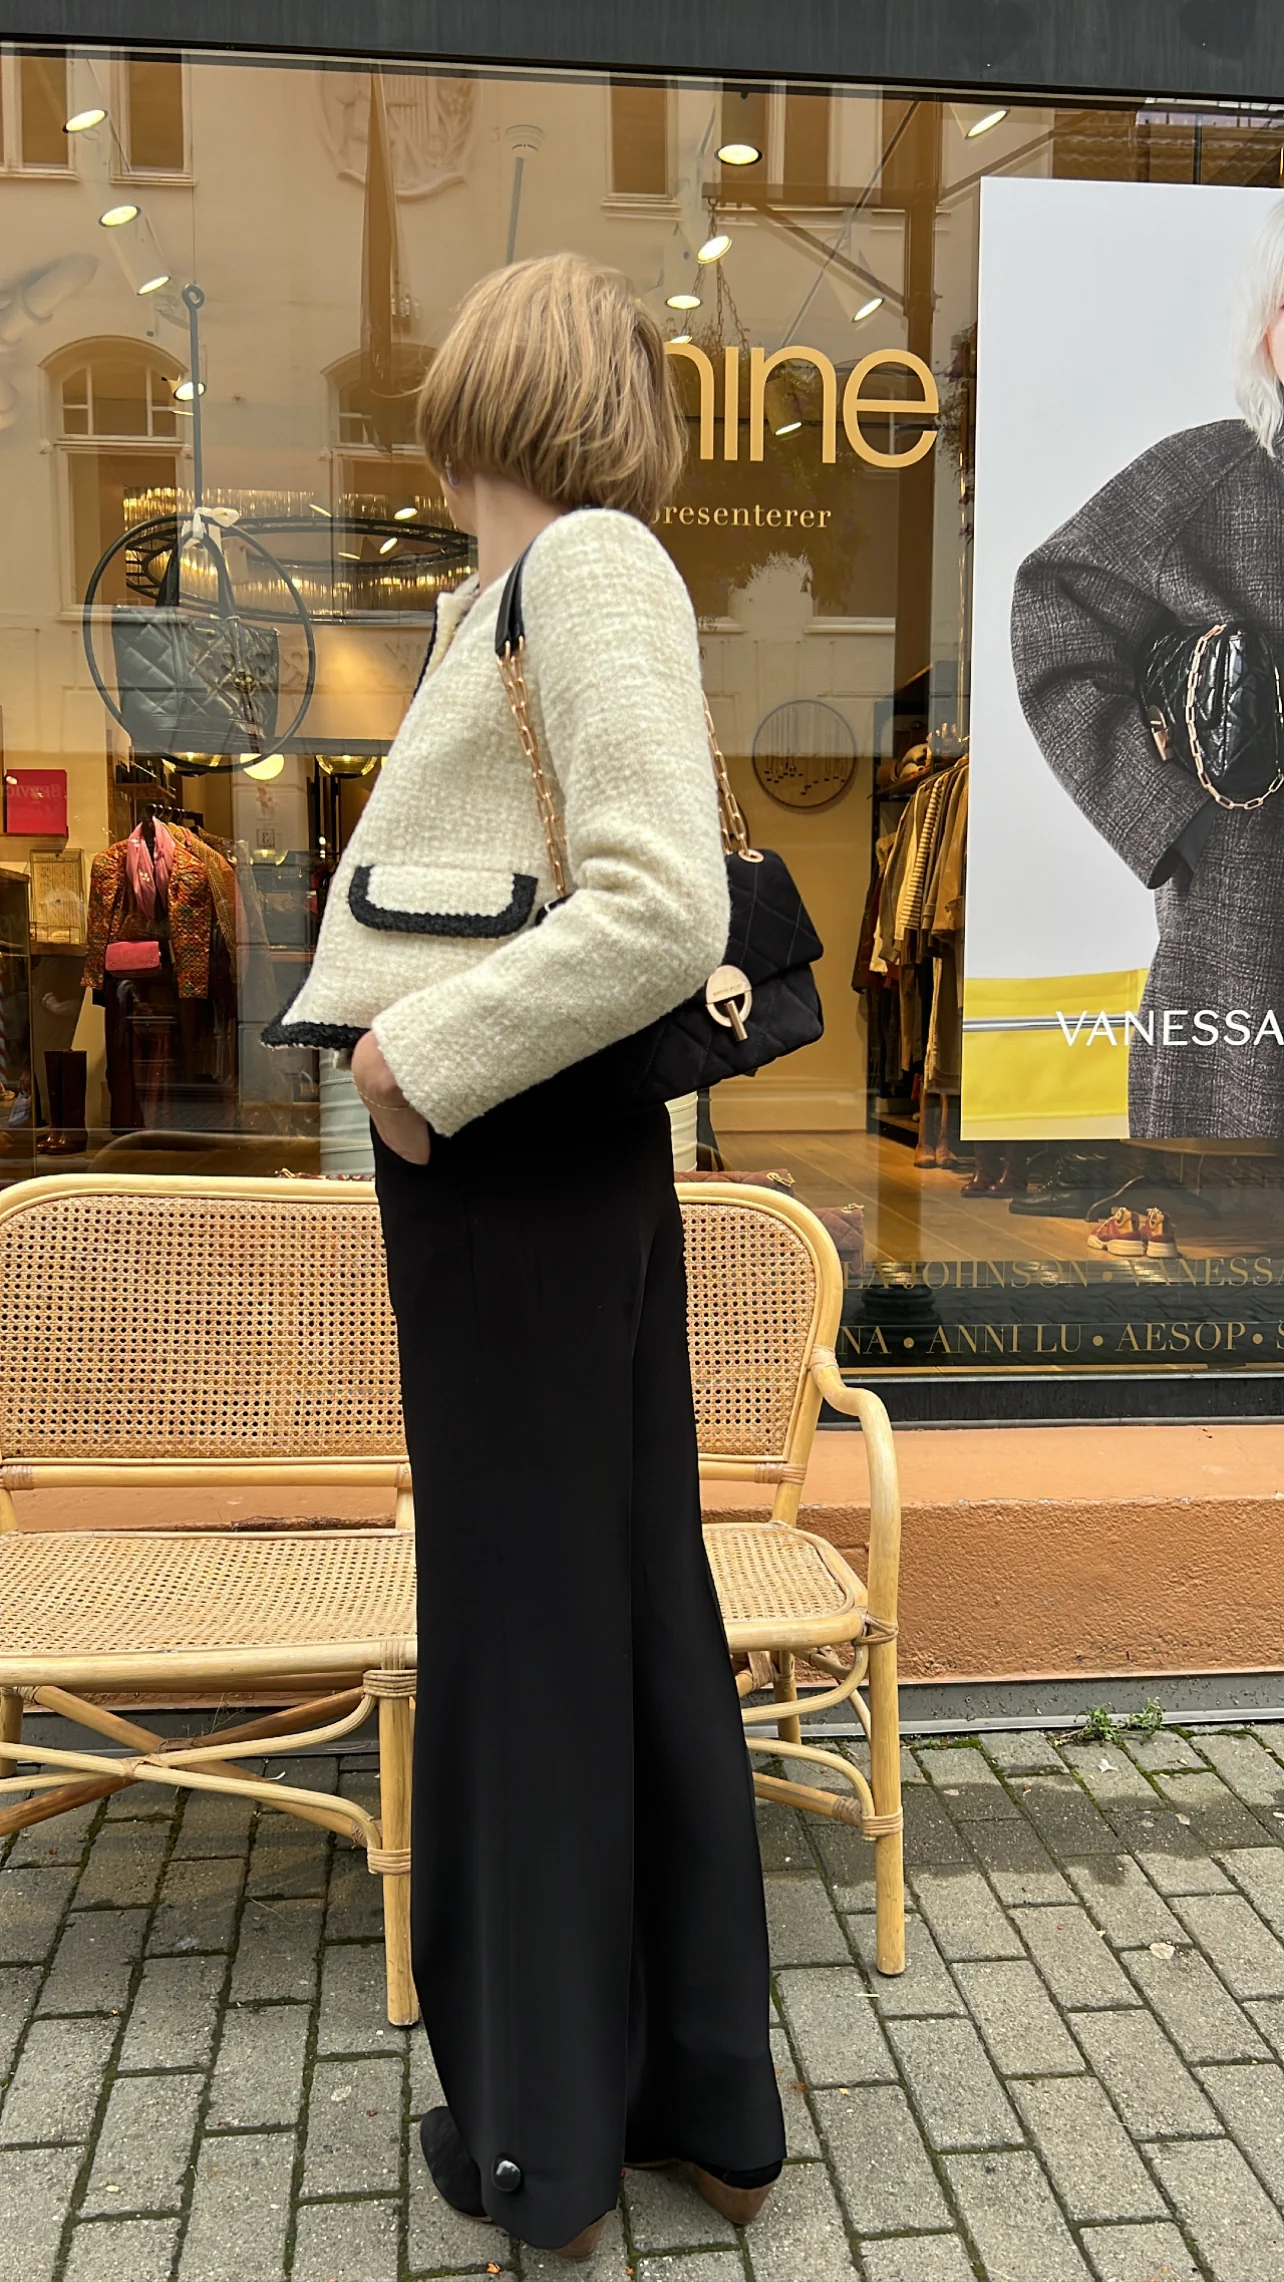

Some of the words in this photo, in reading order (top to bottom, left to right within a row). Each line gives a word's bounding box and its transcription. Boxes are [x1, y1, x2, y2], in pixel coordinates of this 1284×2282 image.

[1056, 1009, 1284, 1047] VANESSA
[902, 1260, 1089, 1290] JOHNSON
[1114, 1321, 1246, 1353] AESOP
